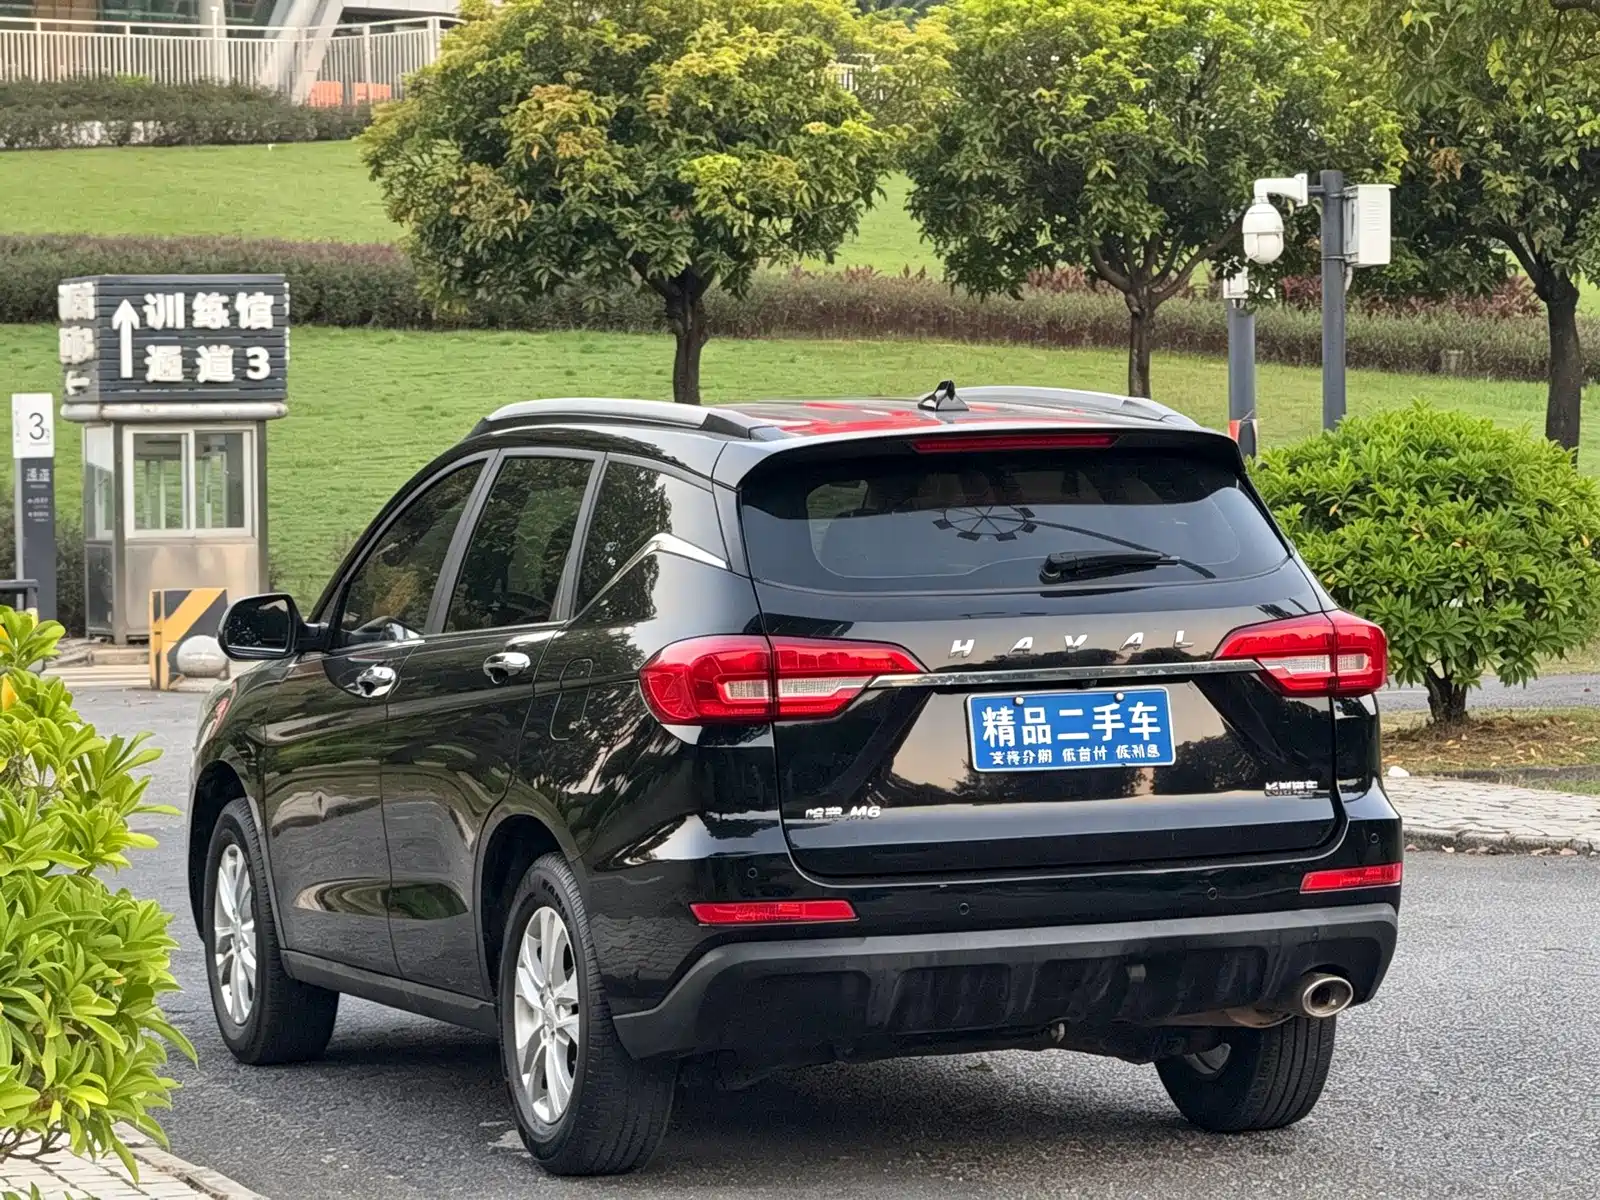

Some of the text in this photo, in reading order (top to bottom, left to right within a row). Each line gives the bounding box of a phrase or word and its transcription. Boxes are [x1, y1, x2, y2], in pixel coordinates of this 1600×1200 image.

[949, 630, 1195, 658] HAVAL
[982, 701, 1161, 748] 精品二手车
[989, 750, 1053, 766] 支持分期
[1062, 746, 1107, 763] 低首付
[850, 805, 881, 820] M6
